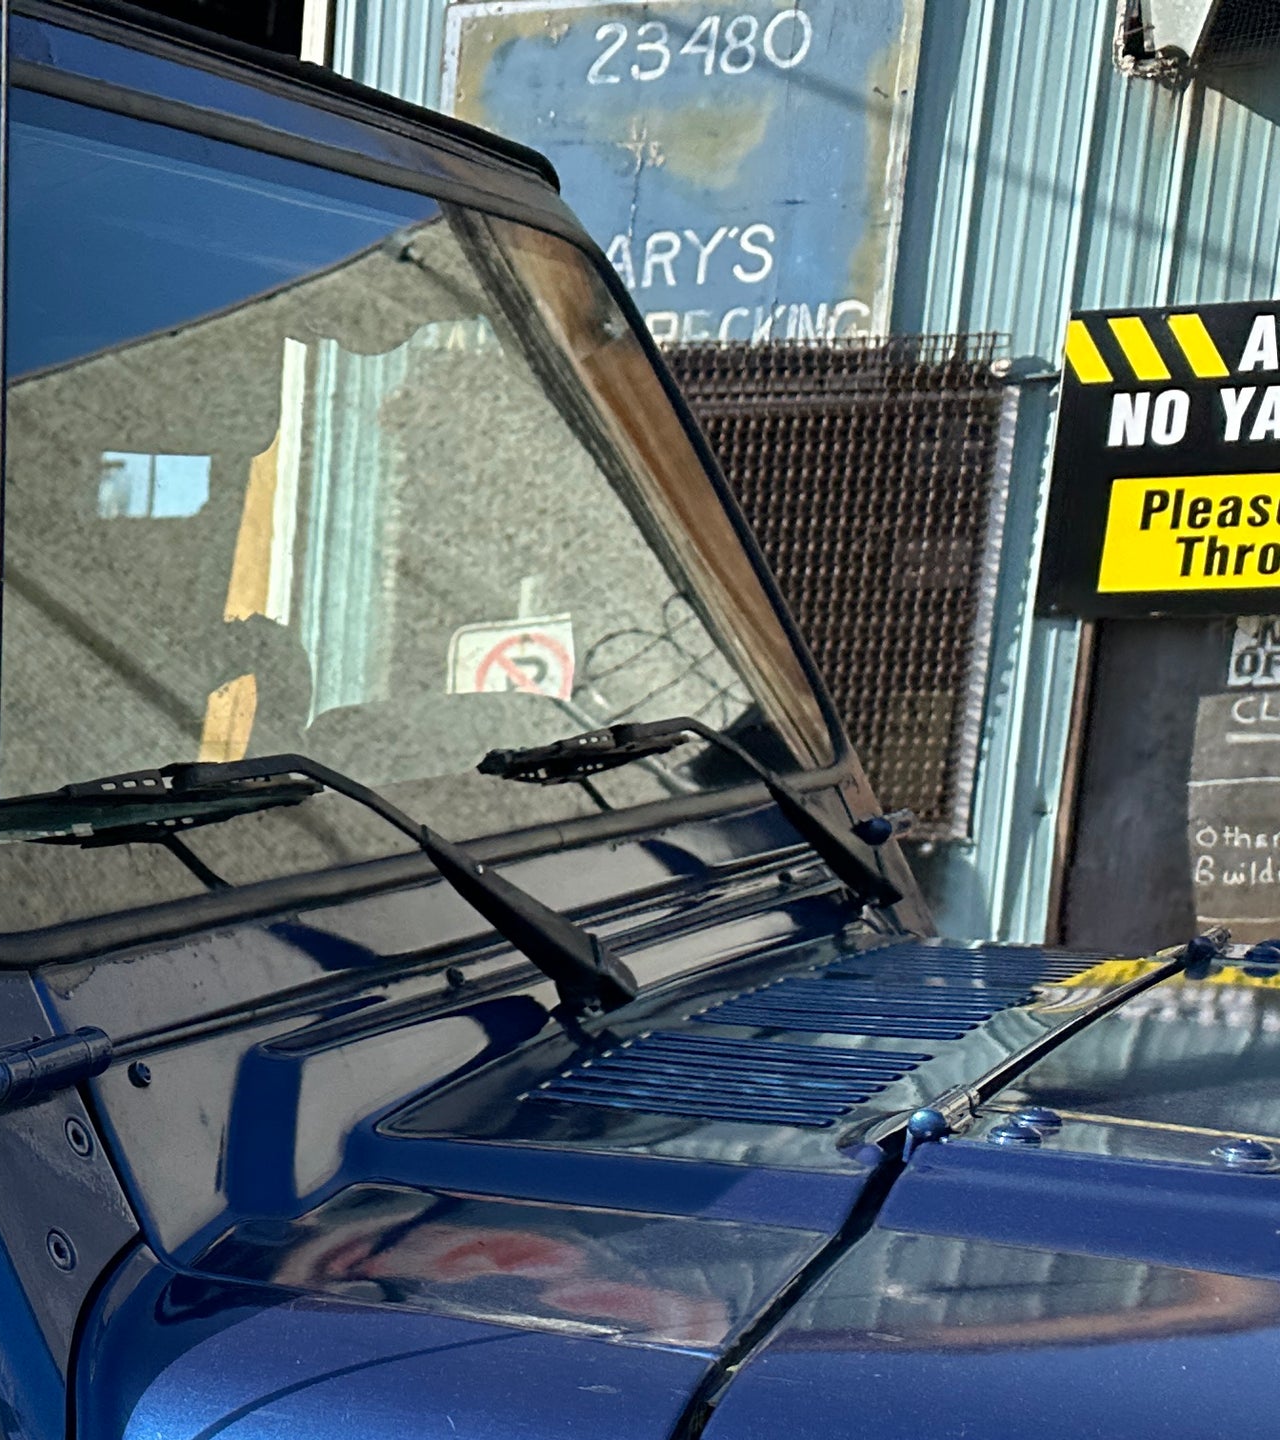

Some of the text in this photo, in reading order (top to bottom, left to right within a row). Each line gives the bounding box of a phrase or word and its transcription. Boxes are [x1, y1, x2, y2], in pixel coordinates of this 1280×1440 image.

[586, 8, 812, 85] 23480
[1106, 388, 1191, 448] NO
[1139, 488, 1280, 531] Pleas
[1195, 855, 1280, 885] Build
